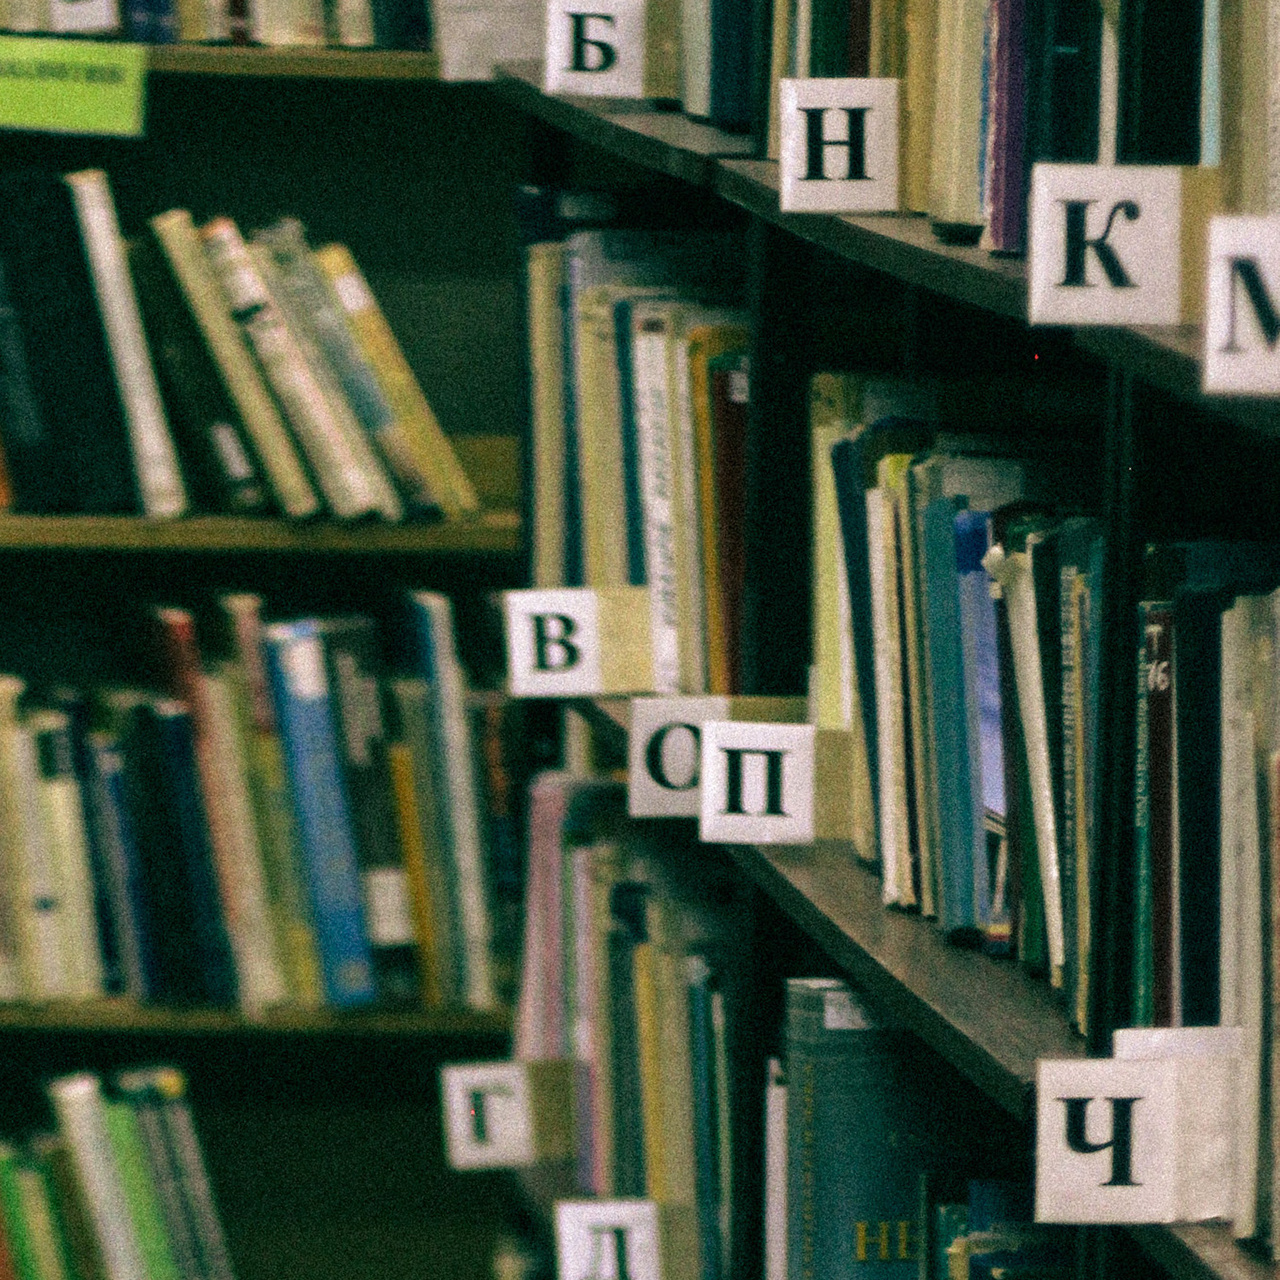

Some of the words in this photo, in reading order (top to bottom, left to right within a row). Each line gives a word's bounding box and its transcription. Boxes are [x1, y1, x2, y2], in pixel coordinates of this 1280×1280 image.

[568, 12, 618, 74] Б
[797, 106, 872, 182] Н
[1054, 199, 1141, 290] К
[530, 613, 582, 673] В
[718, 747, 791, 818] П
[467, 1085, 516, 1146] Г
[1060, 1096, 1144, 1188] Ч
